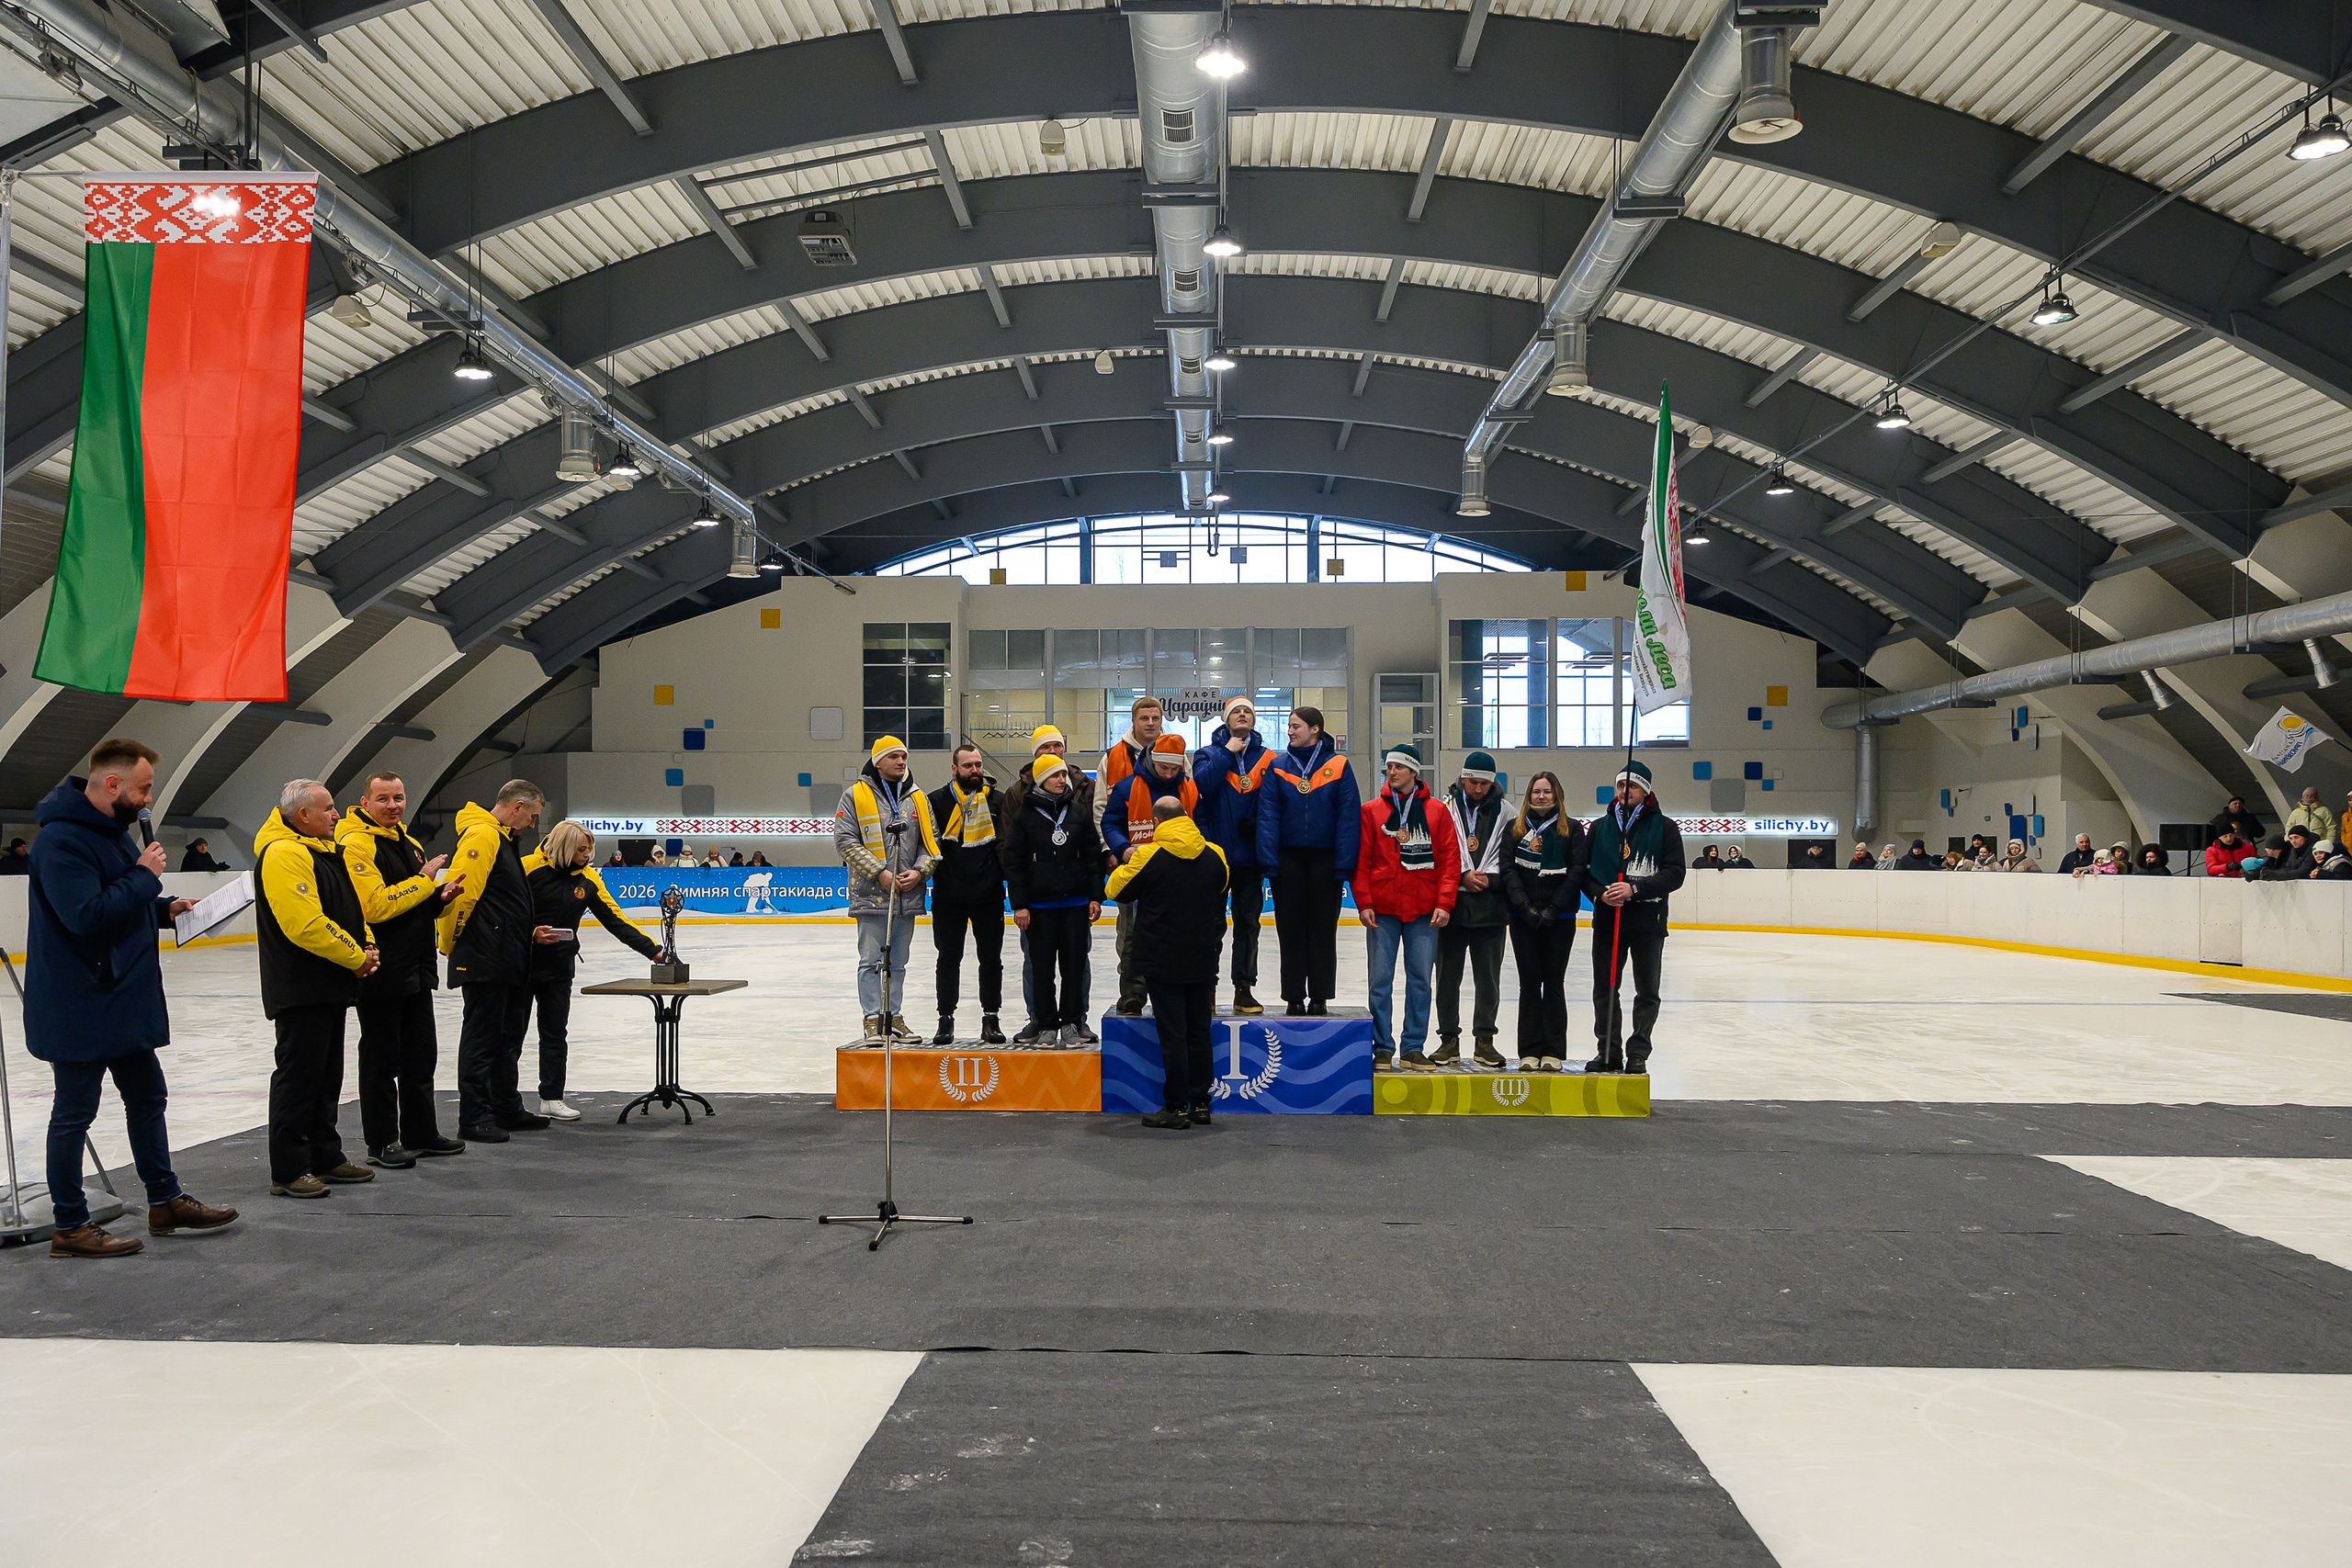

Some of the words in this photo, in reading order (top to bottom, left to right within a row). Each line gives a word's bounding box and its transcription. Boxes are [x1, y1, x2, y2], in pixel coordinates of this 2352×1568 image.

[1645, 637, 1677, 691] леса
[582, 819, 643, 833] ilichy.by
[1754, 819, 1829, 833] silichy.by
[618, 884, 656, 899] 2026
[733, 886, 833, 901] спартакиада
[1221, 1021, 1249, 1080] I
[954, 1057, 984, 1087] II
[1498, 1078, 1525, 1096] III
